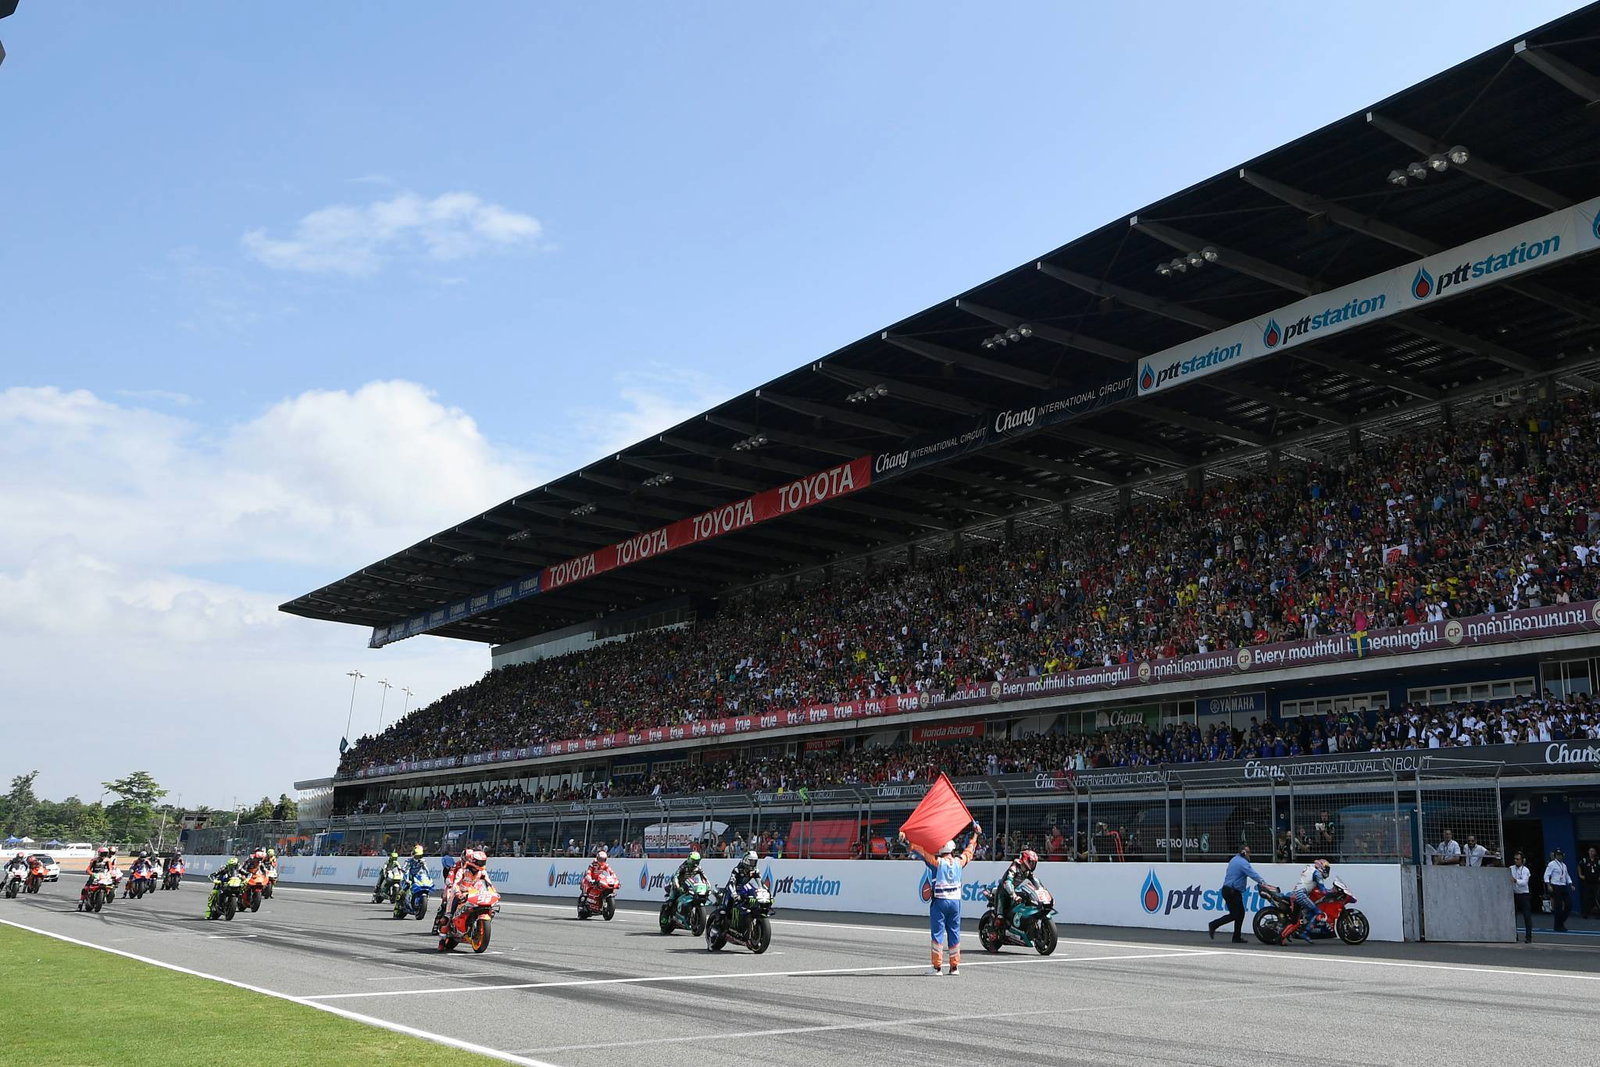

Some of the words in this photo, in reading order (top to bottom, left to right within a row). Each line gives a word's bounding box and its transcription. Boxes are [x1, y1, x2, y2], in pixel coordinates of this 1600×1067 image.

[995, 406, 1036, 433] Chang
[1037, 392, 1097, 416] INTERNATIONAL
[1099, 377, 1132, 397] CIRCUIT
[875, 450, 909, 473] Chang
[910, 438, 958, 459] INTERNATIONAL
[960, 427, 987, 444] CIRCUIT
[778, 464, 854, 512] TOYOTA
[692, 500, 754, 539] TOYOTA
[616, 528, 668, 565] TOYOTA
[550, 554, 596, 587] TOYOTA
[1447, 627, 1460, 638] CP
[1467, 608, 1586, 643] ทุกคำมีความหมาย
[1255, 650, 1285, 664] Every
[1288, 638, 1344, 660] mouthful
[1003, 682, 1025, 697] Every
[1076, 666, 1130, 686] meaningful
[834, 705, 852, 719] true
[897, 696, 919, 710] true
[1220, 697, 1255, 713] YAMAHA
[735, 718, 751, 731] true
[760, 715, 777, 728] true
[809, 708, 828, 722] true
[921, 726, 946, 738] Honda
[947, 724, 975, 737] Racing
[1509, 799, 1531, 816] 19
